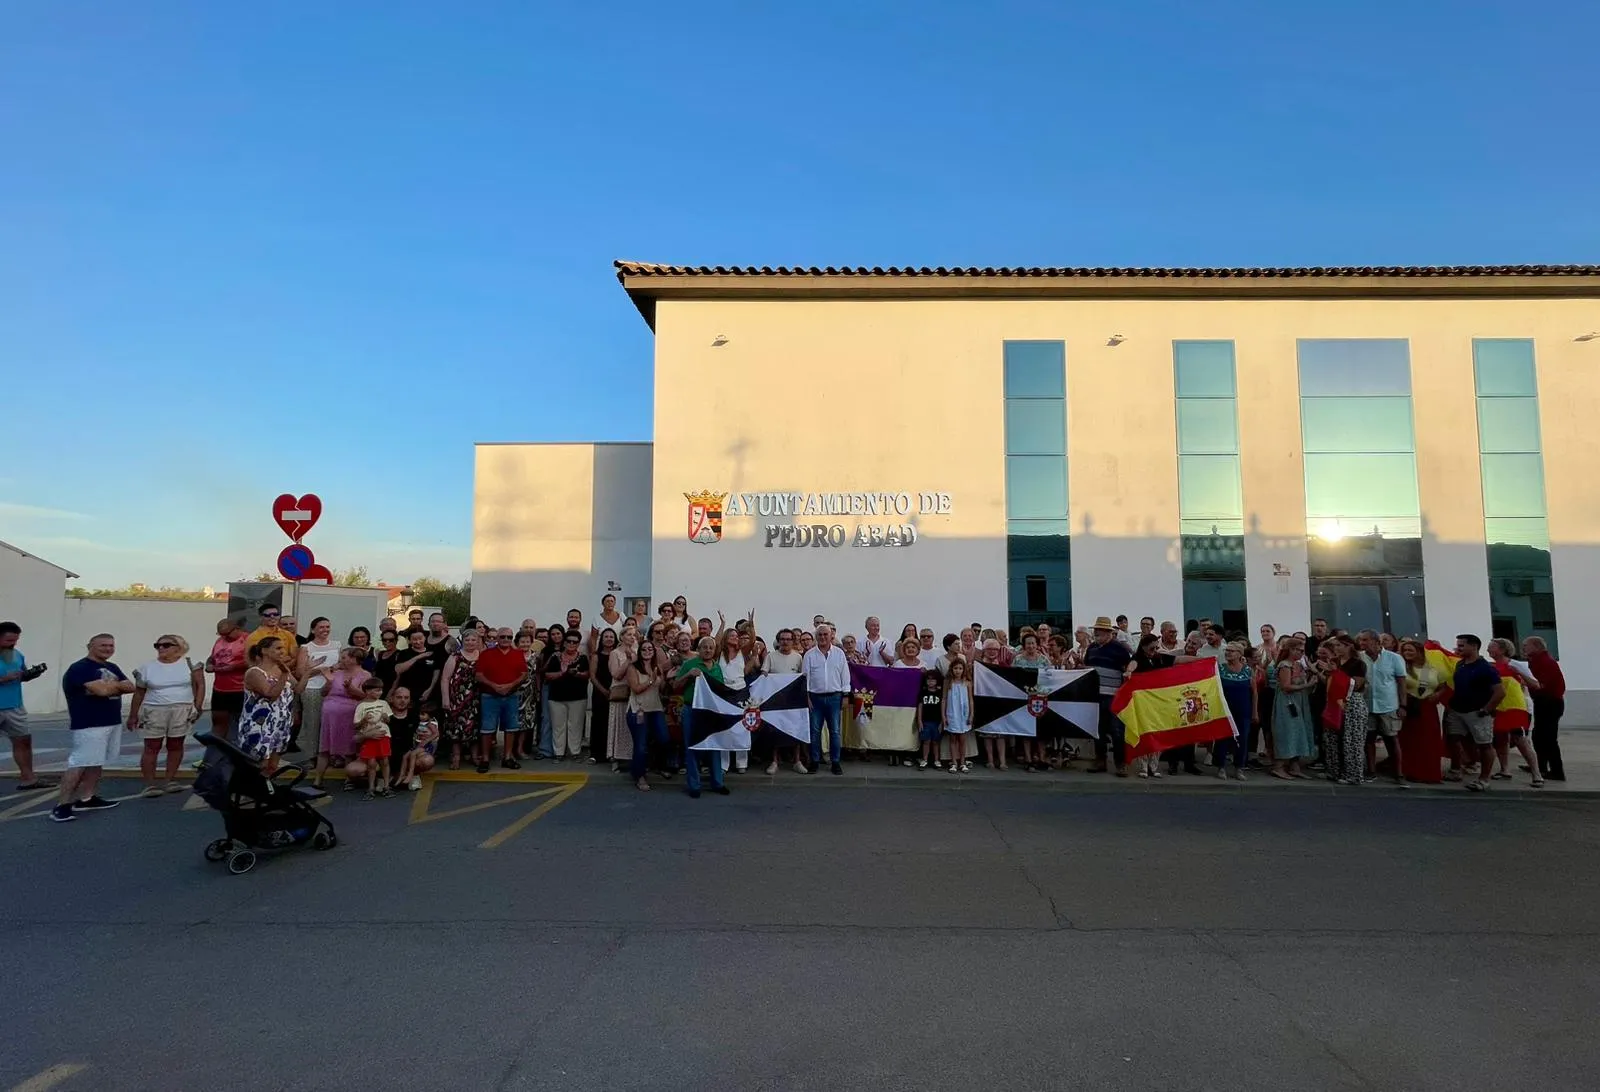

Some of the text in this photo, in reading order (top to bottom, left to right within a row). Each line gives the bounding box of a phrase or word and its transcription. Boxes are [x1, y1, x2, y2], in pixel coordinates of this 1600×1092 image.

[725, 491, 952, 516] AYUNTAMIENTO DE
[764, 523, 918, 548] PEDRO ABAD
[923, 695, 940, 705] GAP
